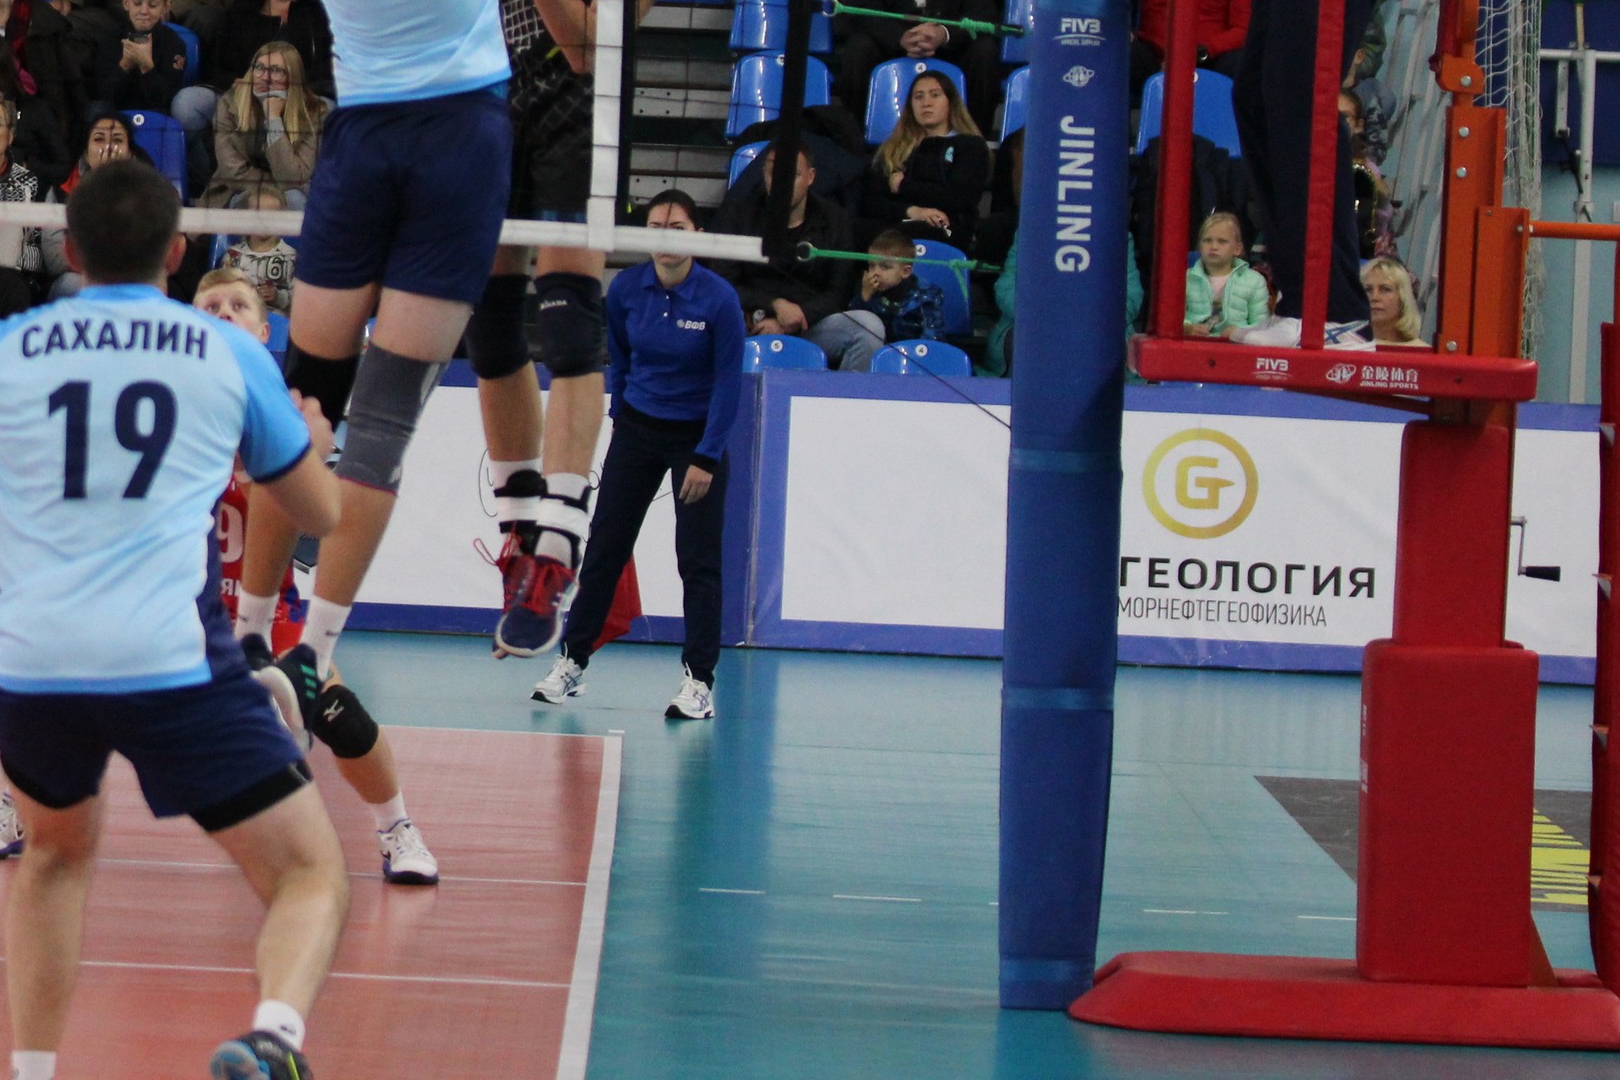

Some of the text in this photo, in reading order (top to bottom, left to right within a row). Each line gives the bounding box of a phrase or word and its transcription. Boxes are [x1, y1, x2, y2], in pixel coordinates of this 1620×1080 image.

[1061, 18, 1100, 34] FIVB
[1054, 115, 1095, 273] JINLING
[22, 320, 208, 361] САХАЛИН
[1256, 358, 1289, 371] FIVB
[48, 381, 176, 500] 19
[1120, 556, 1376, 599] ГЕОЛОГИЯ
[1117, 596, 1327, 627] МОРНЕФТЕГЕОФИЗИКА
